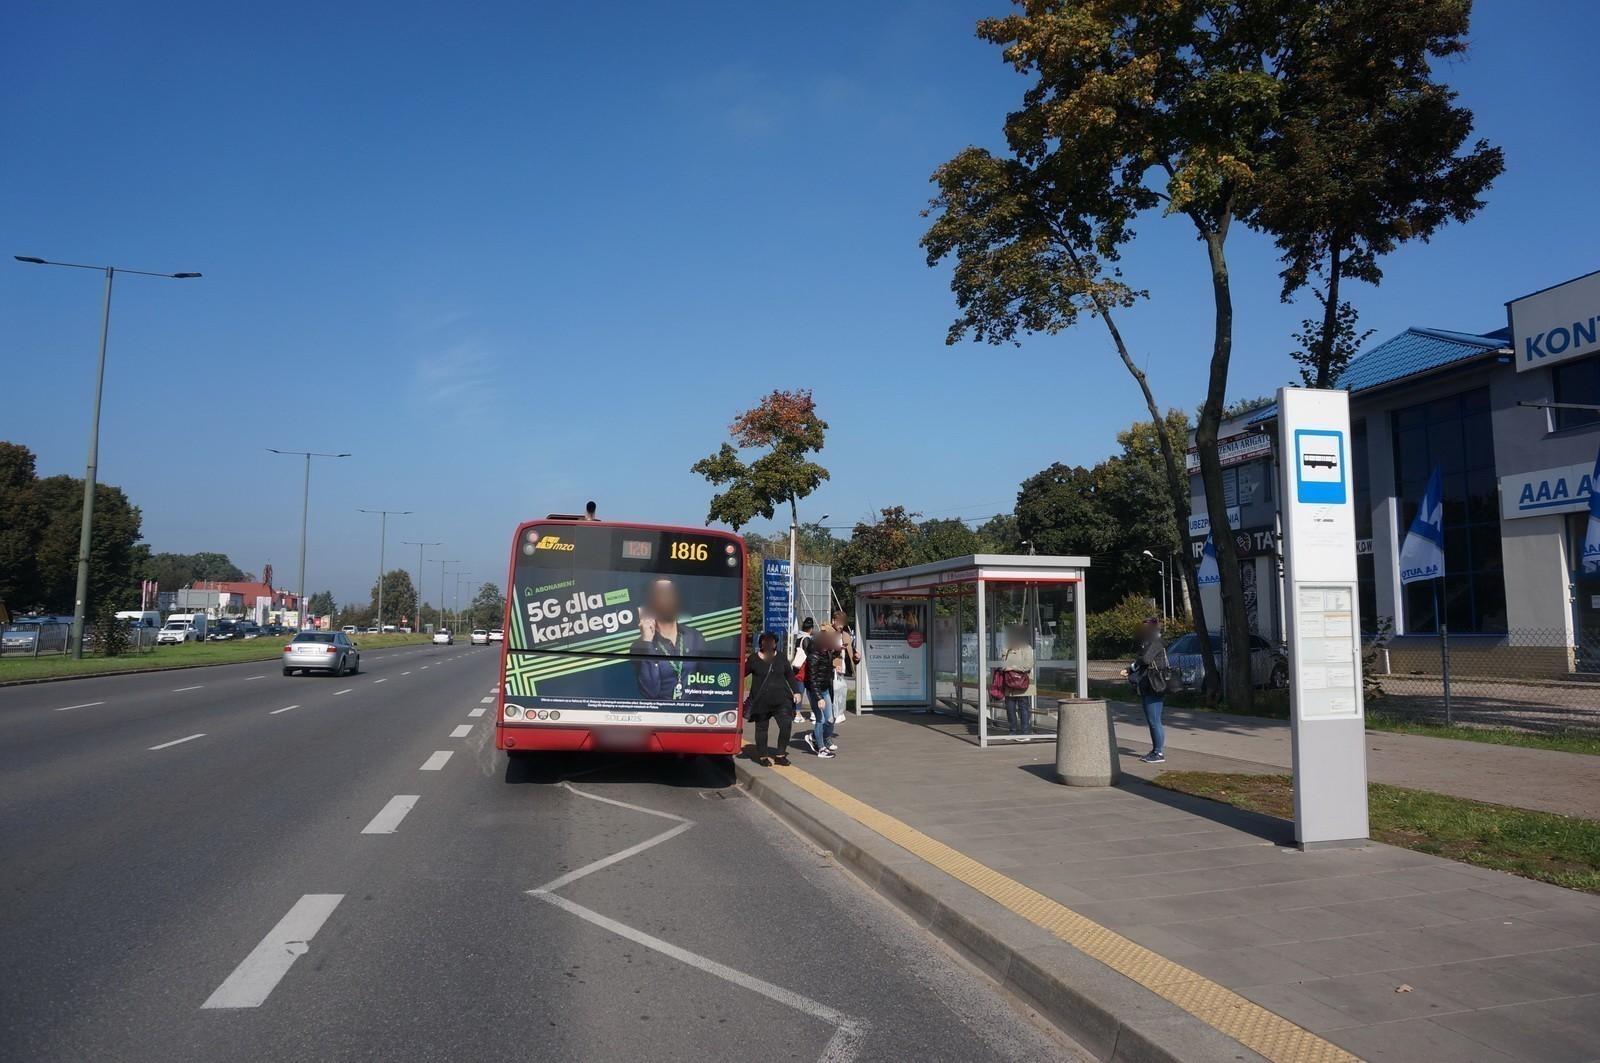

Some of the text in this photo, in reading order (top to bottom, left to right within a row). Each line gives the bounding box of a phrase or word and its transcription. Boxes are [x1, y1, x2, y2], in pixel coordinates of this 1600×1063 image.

[1520, 478, 1569, 503] AAA
[670, 541, 708, 560] 1816
[535, 580, 575, 593] ABONAMENT
[527, 598, 561, 622] 5G
[565, 591, 603, 614] dla
[531, 609, 633, 643] każdego
[687, 672, 715, 685] plus
